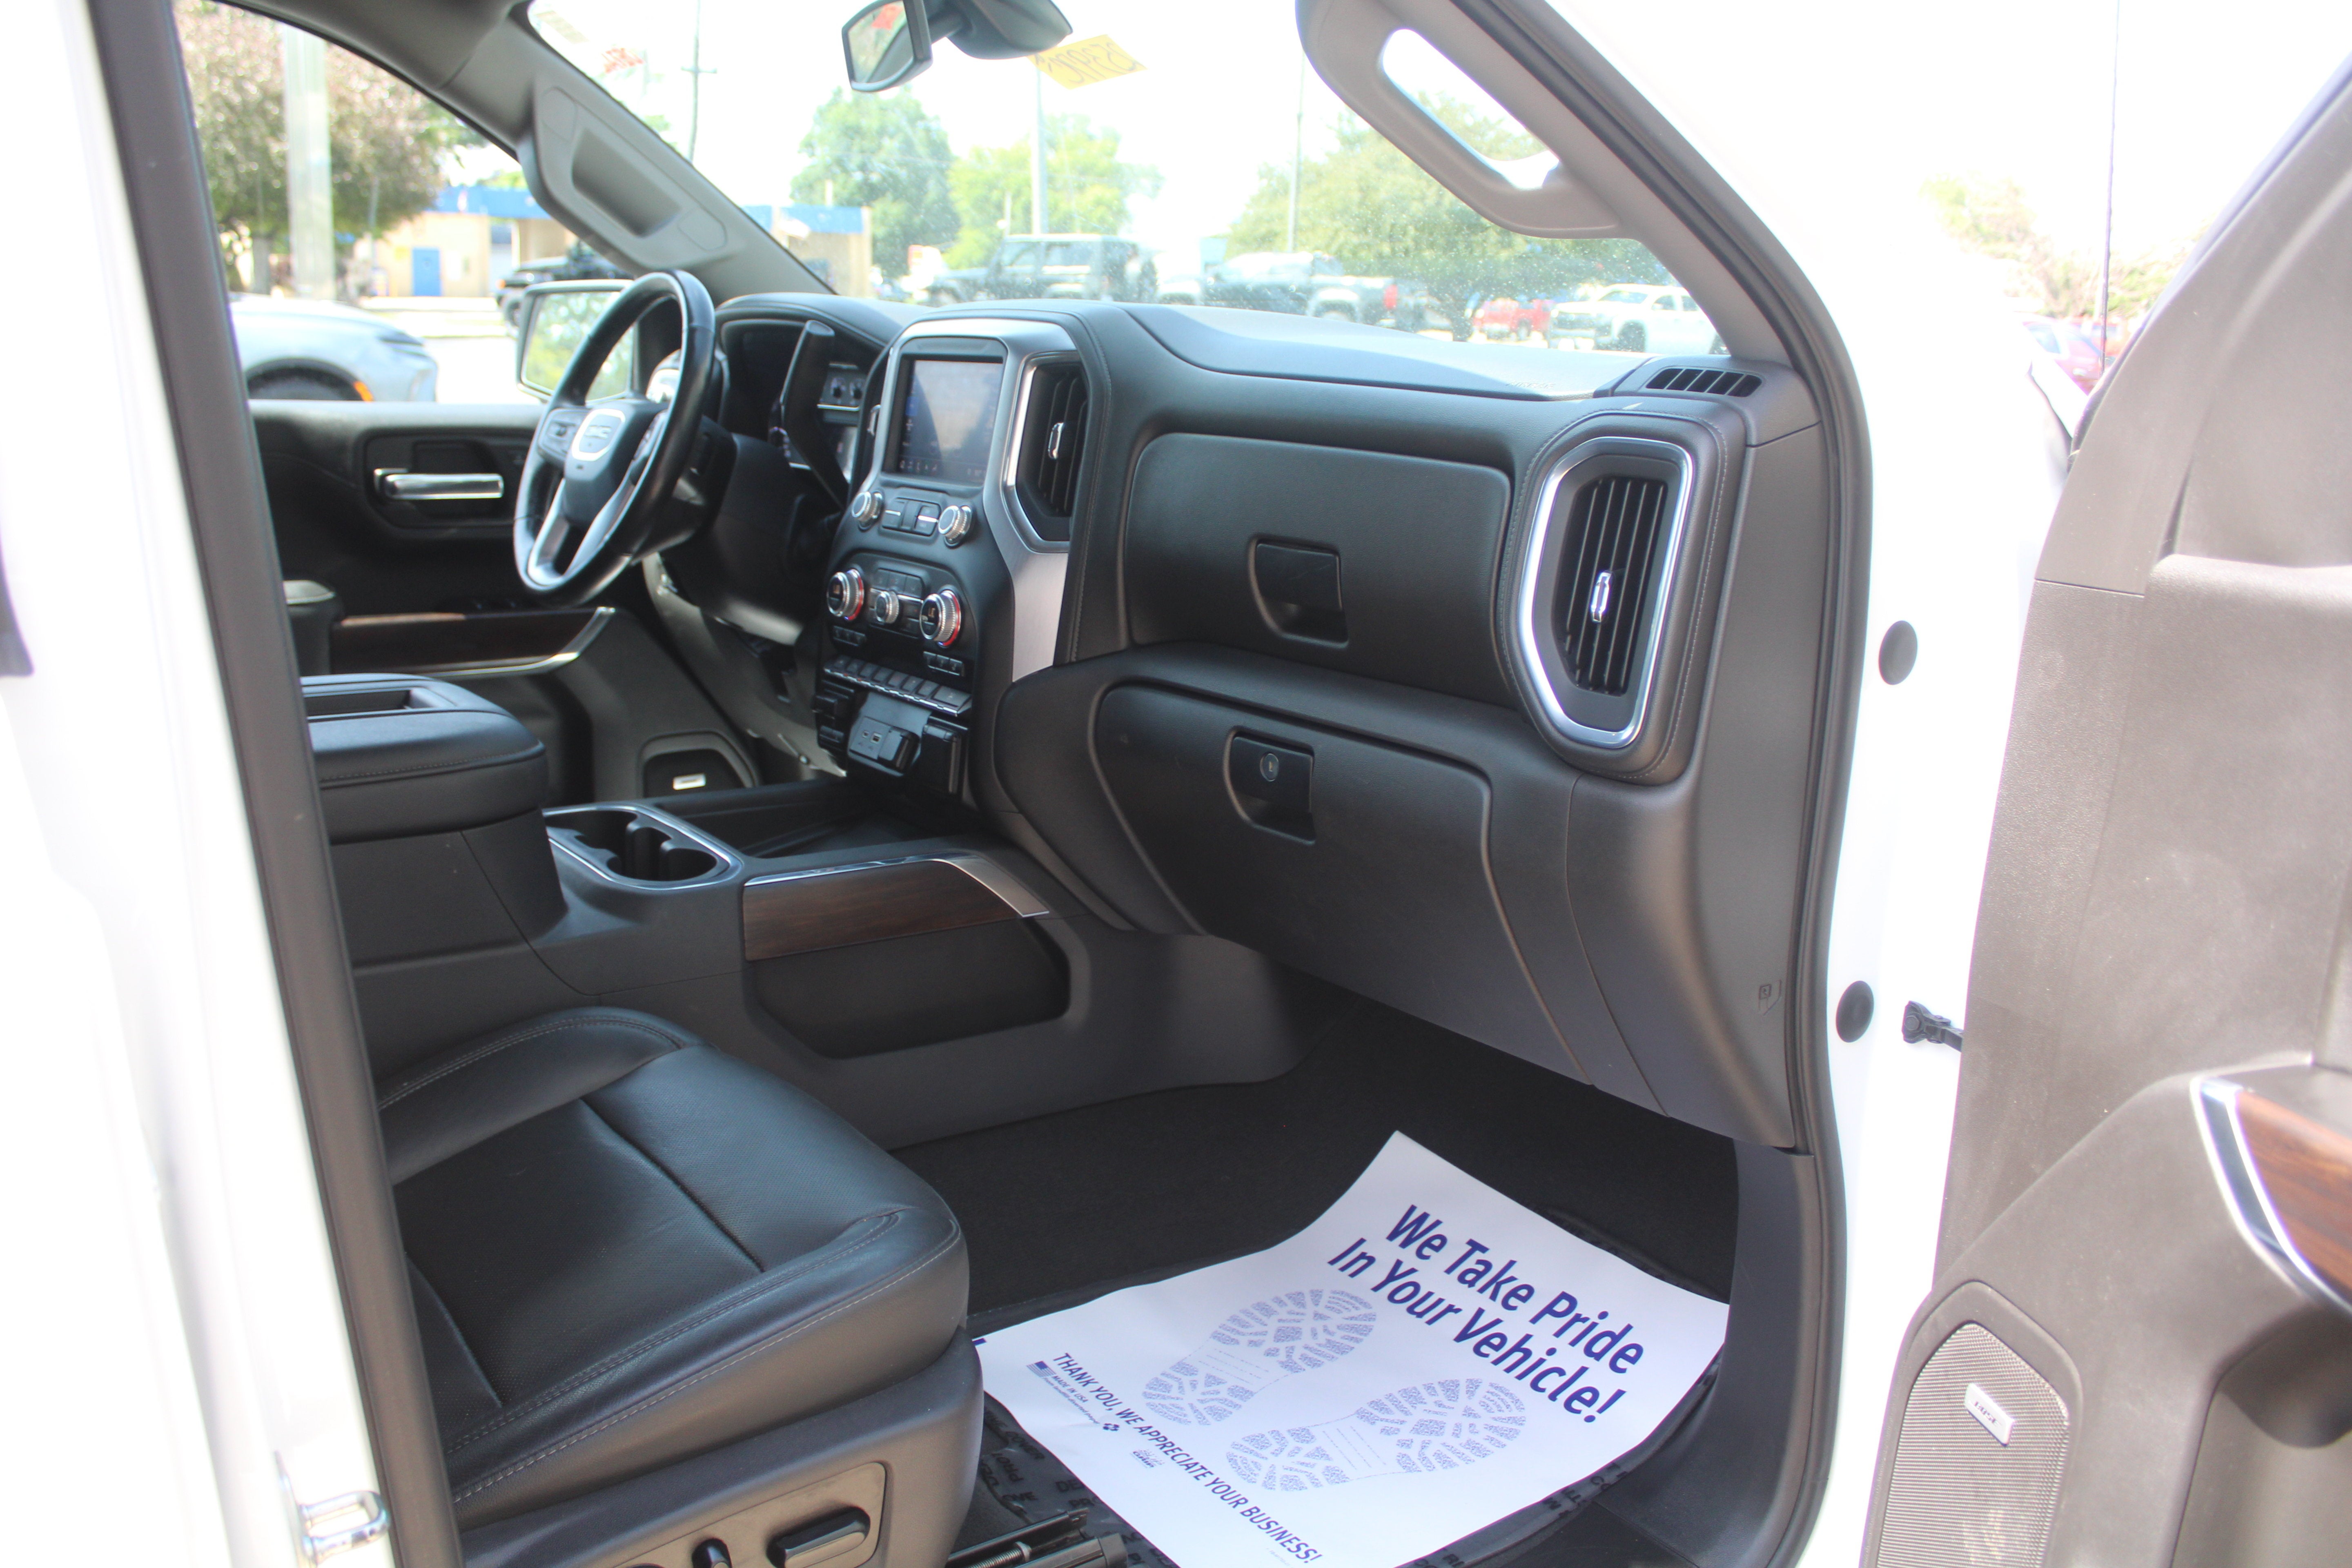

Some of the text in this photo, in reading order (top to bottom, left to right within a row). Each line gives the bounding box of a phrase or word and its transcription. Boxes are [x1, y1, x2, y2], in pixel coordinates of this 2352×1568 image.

[1327, 1237, 1627, 1423] In Your Vehicle!
[1386, 1204, 1644, 1374] We Take Pride
[1051, 1376, 1070, 1388] MADE
[1074, 1393, 1089, 1403] USA
[1053, 1352, 1099, 1387] THANK
[1089, 1386, 1123, 1411] YOU,
[1115, 1408, 1145, 1425] WE
[1133, 1425, 1215, 1481] APPRECIATE
[1204, 1477, 1249, 1508] YOUR
[1239, 1506, 1323, 1564] BUSINESS!
